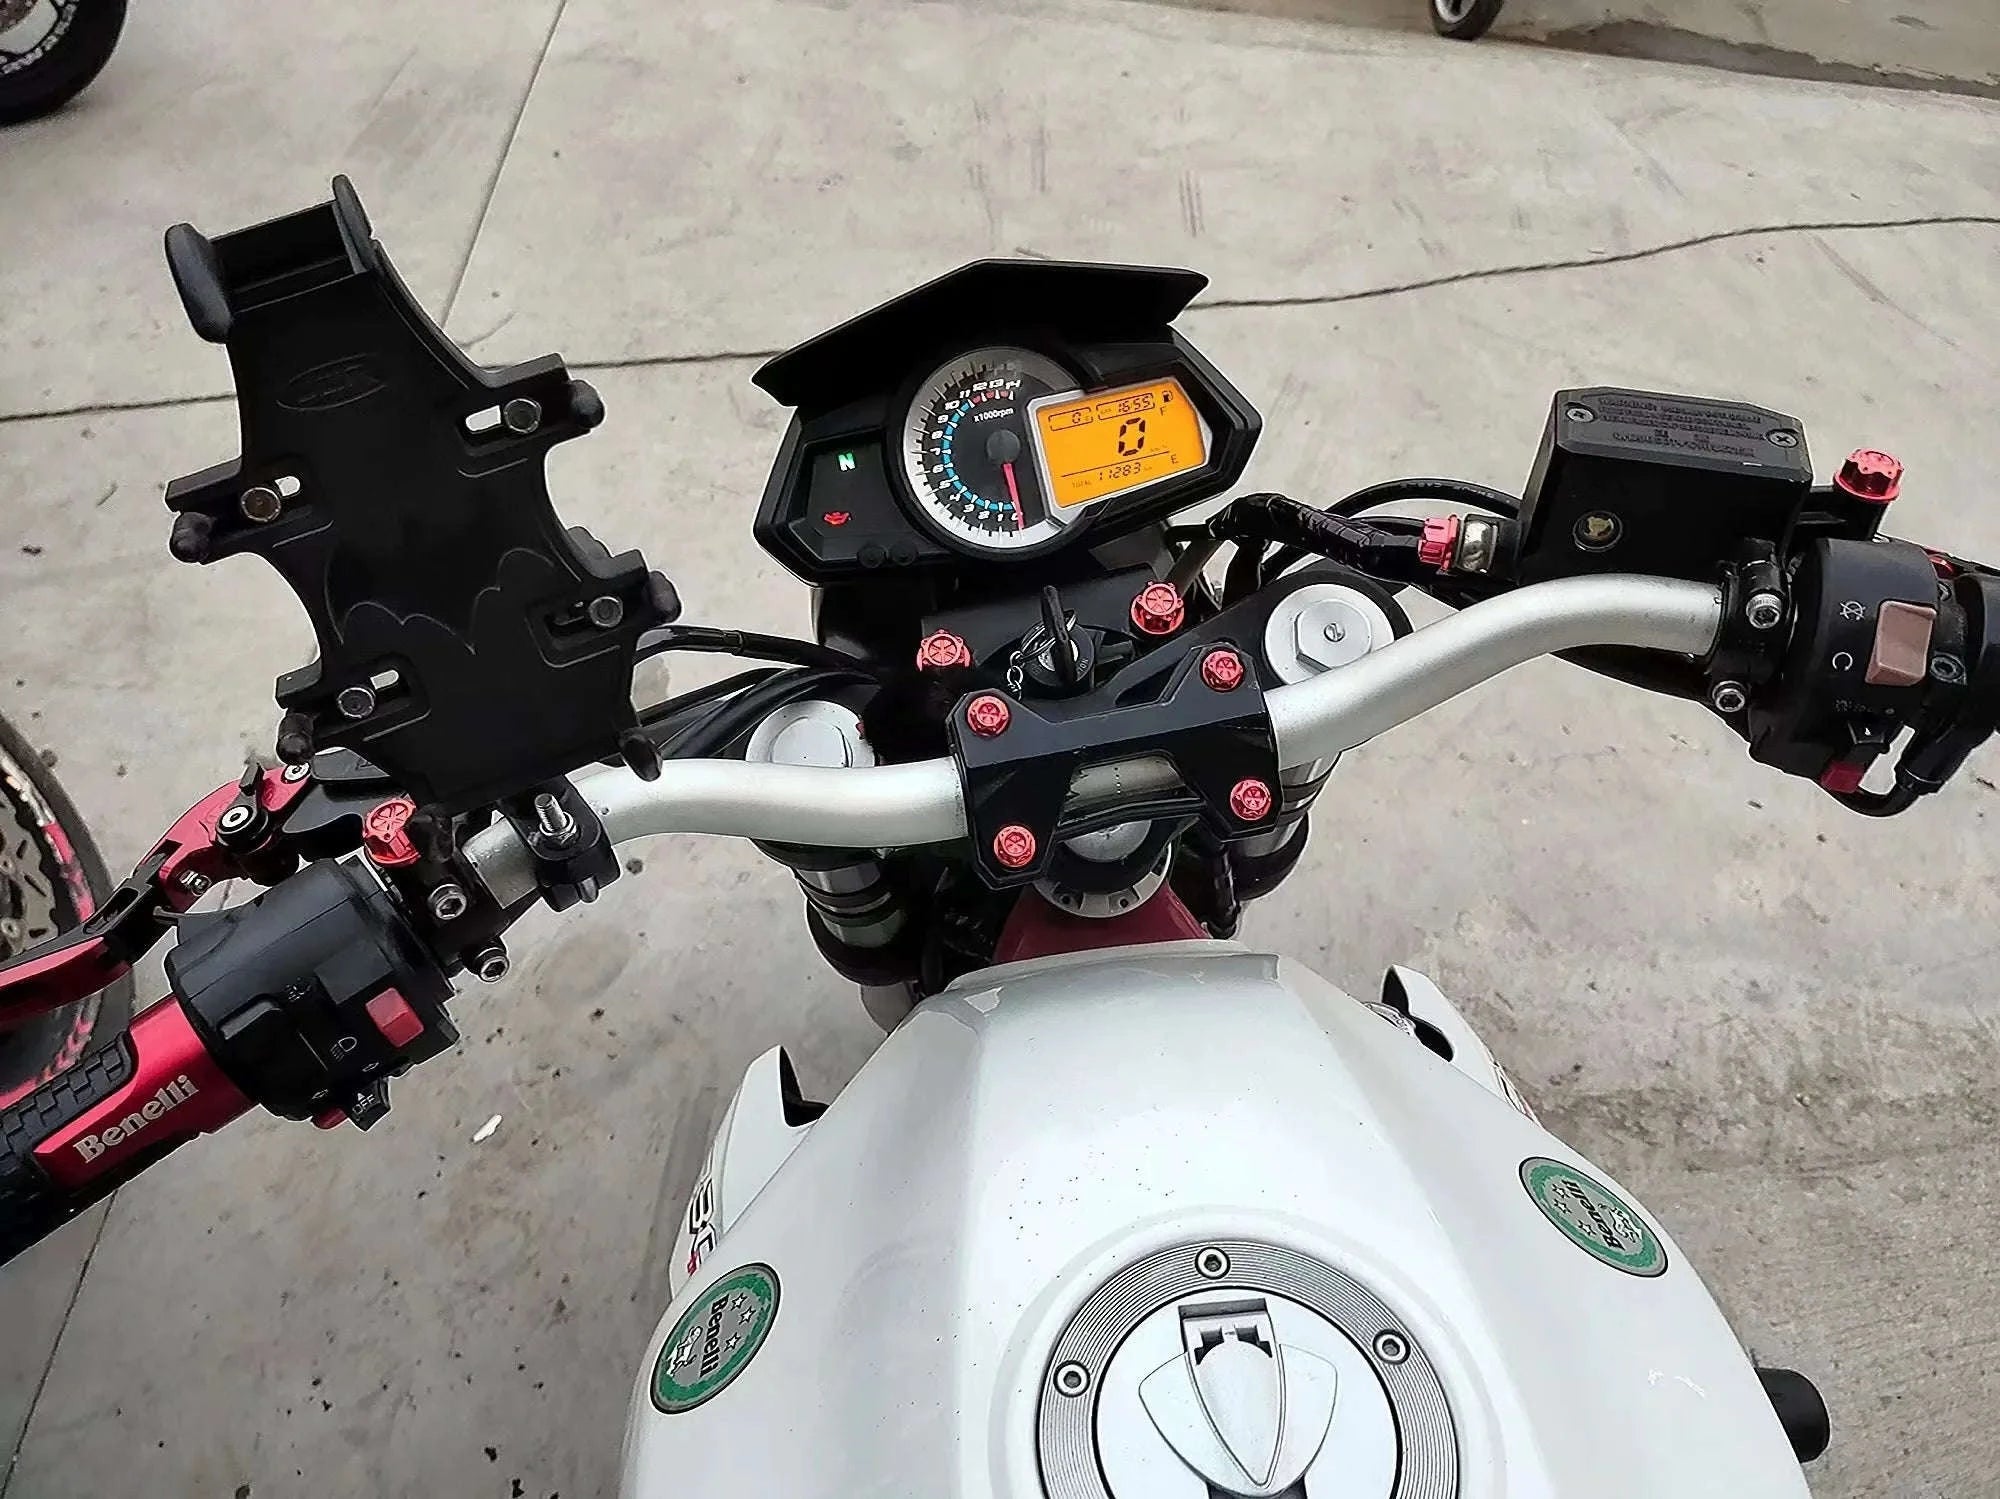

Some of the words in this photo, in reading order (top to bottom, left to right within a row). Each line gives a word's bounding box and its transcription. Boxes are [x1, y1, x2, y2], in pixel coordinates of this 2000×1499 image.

[960, 389, 971, 398] 11
[945, 400, 960, 410] 10
[1160, 406, 1167, 416] F
[937, 415, 949, 423] 9
[973, 408, 1014, 422] x1000rpm
[1118, 417, 1146, 456] 0
[838, 452, 856, 471] N
[1171, 454, 1179, 464] E
[1099, 462, 1141, 480] 11283
[352, 1094, 375, 1115] OFF
[72, 1074, 200, 1164] Benelli
[1561, 1179, 1626, 1251] Benelli
[700, 1292, 730, 1380] Benelli
